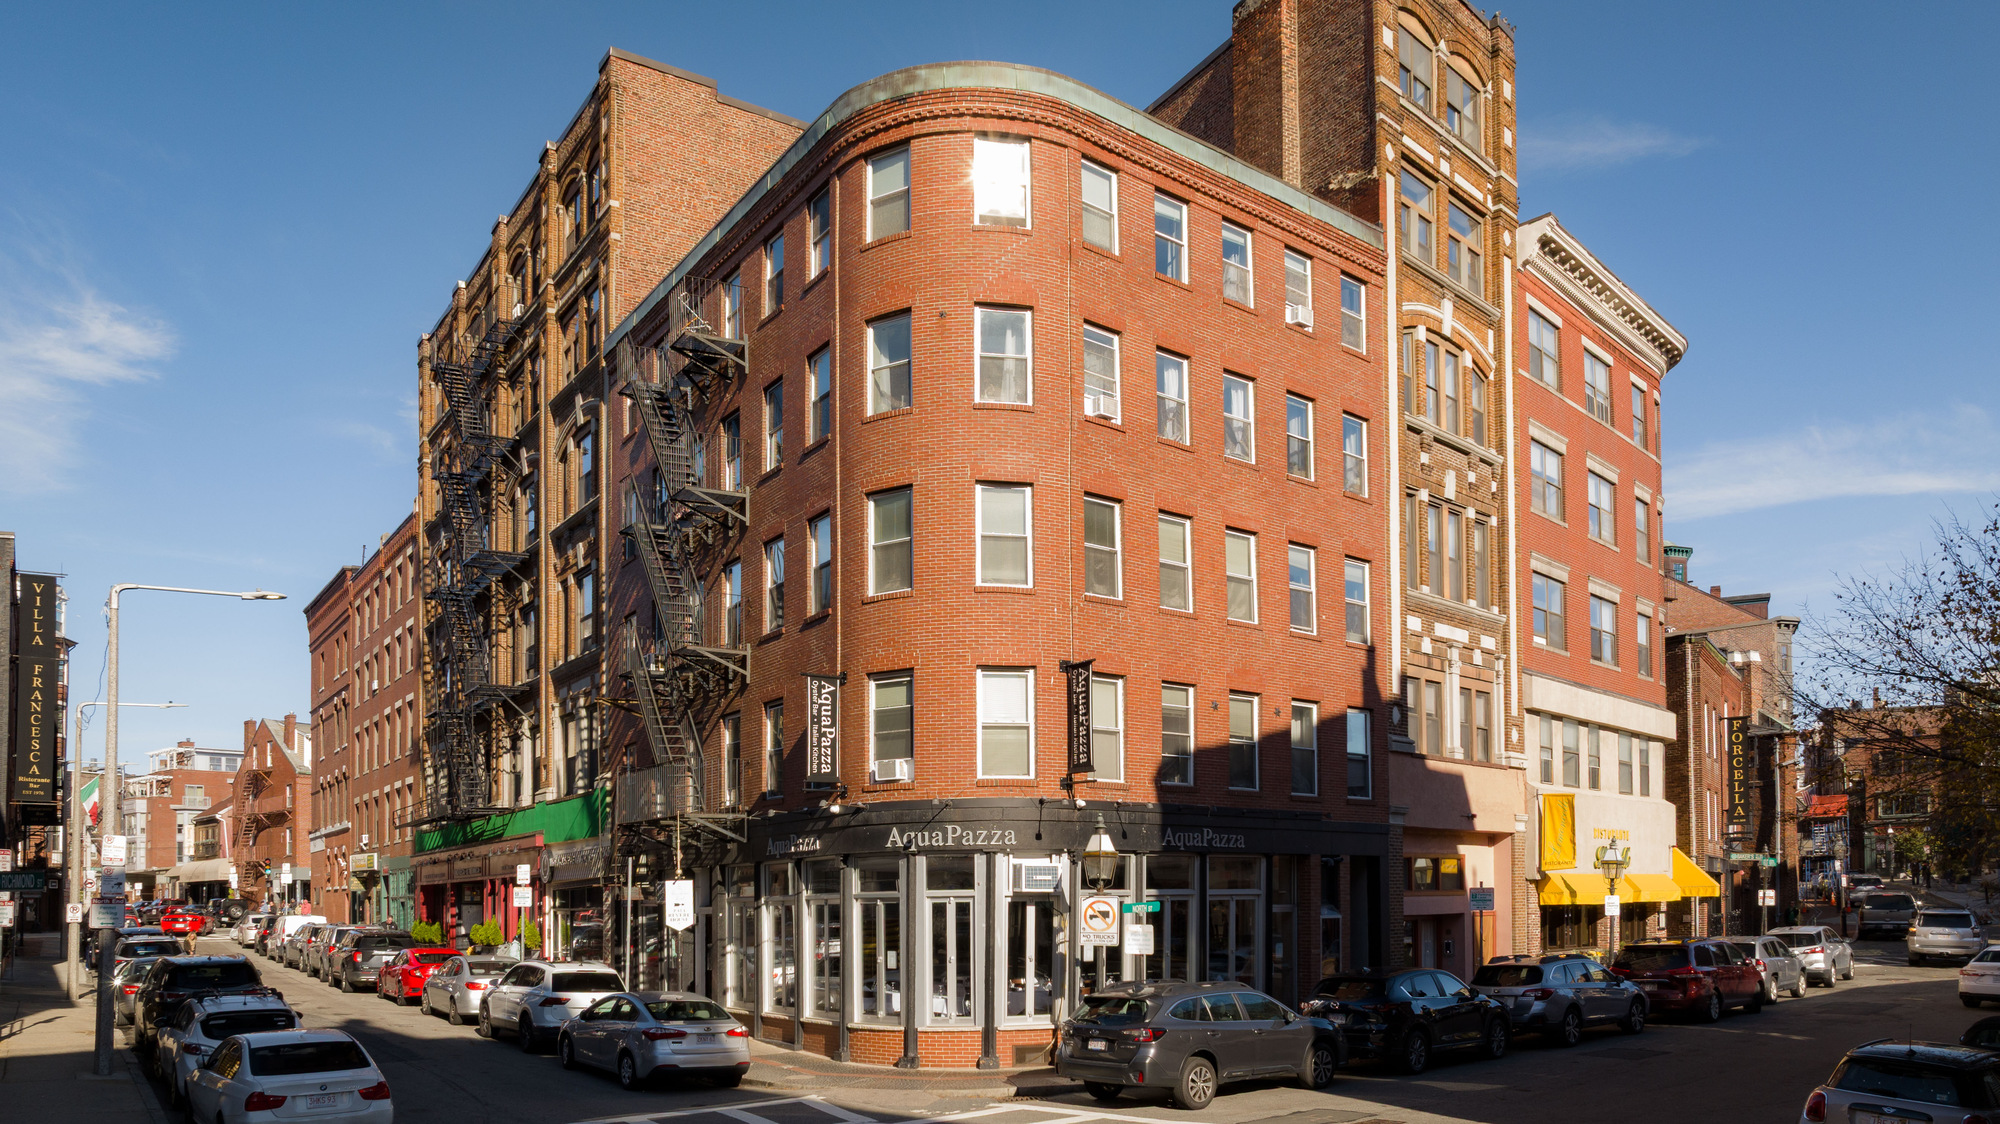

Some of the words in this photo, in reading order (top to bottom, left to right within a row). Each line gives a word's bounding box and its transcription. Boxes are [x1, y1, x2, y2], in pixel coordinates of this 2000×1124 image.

[32, 582, 45, 646] VILLA
[811, 680, 819, 703] Oyster
[29, 664, 44, 775] FRANCESCA
[818, 680, 836, 774] AquaPazza
[1076, 667, 1089, 764] AquaPazza
[1732, 720, 1745, 816] FORCELLA
[766, 834, 820, 857] AquaPazza
[885, 825, 1017, 850] AquaPazza
[1162, 827, 1245, 851] AquaPazza
[1593, 827, 1629, 841] RISTORANTE
[2, 874, 35, 888] RICHMOND
[37, 878, 43, 888] ST
[1132, 905, 1147, 913] NORTH
